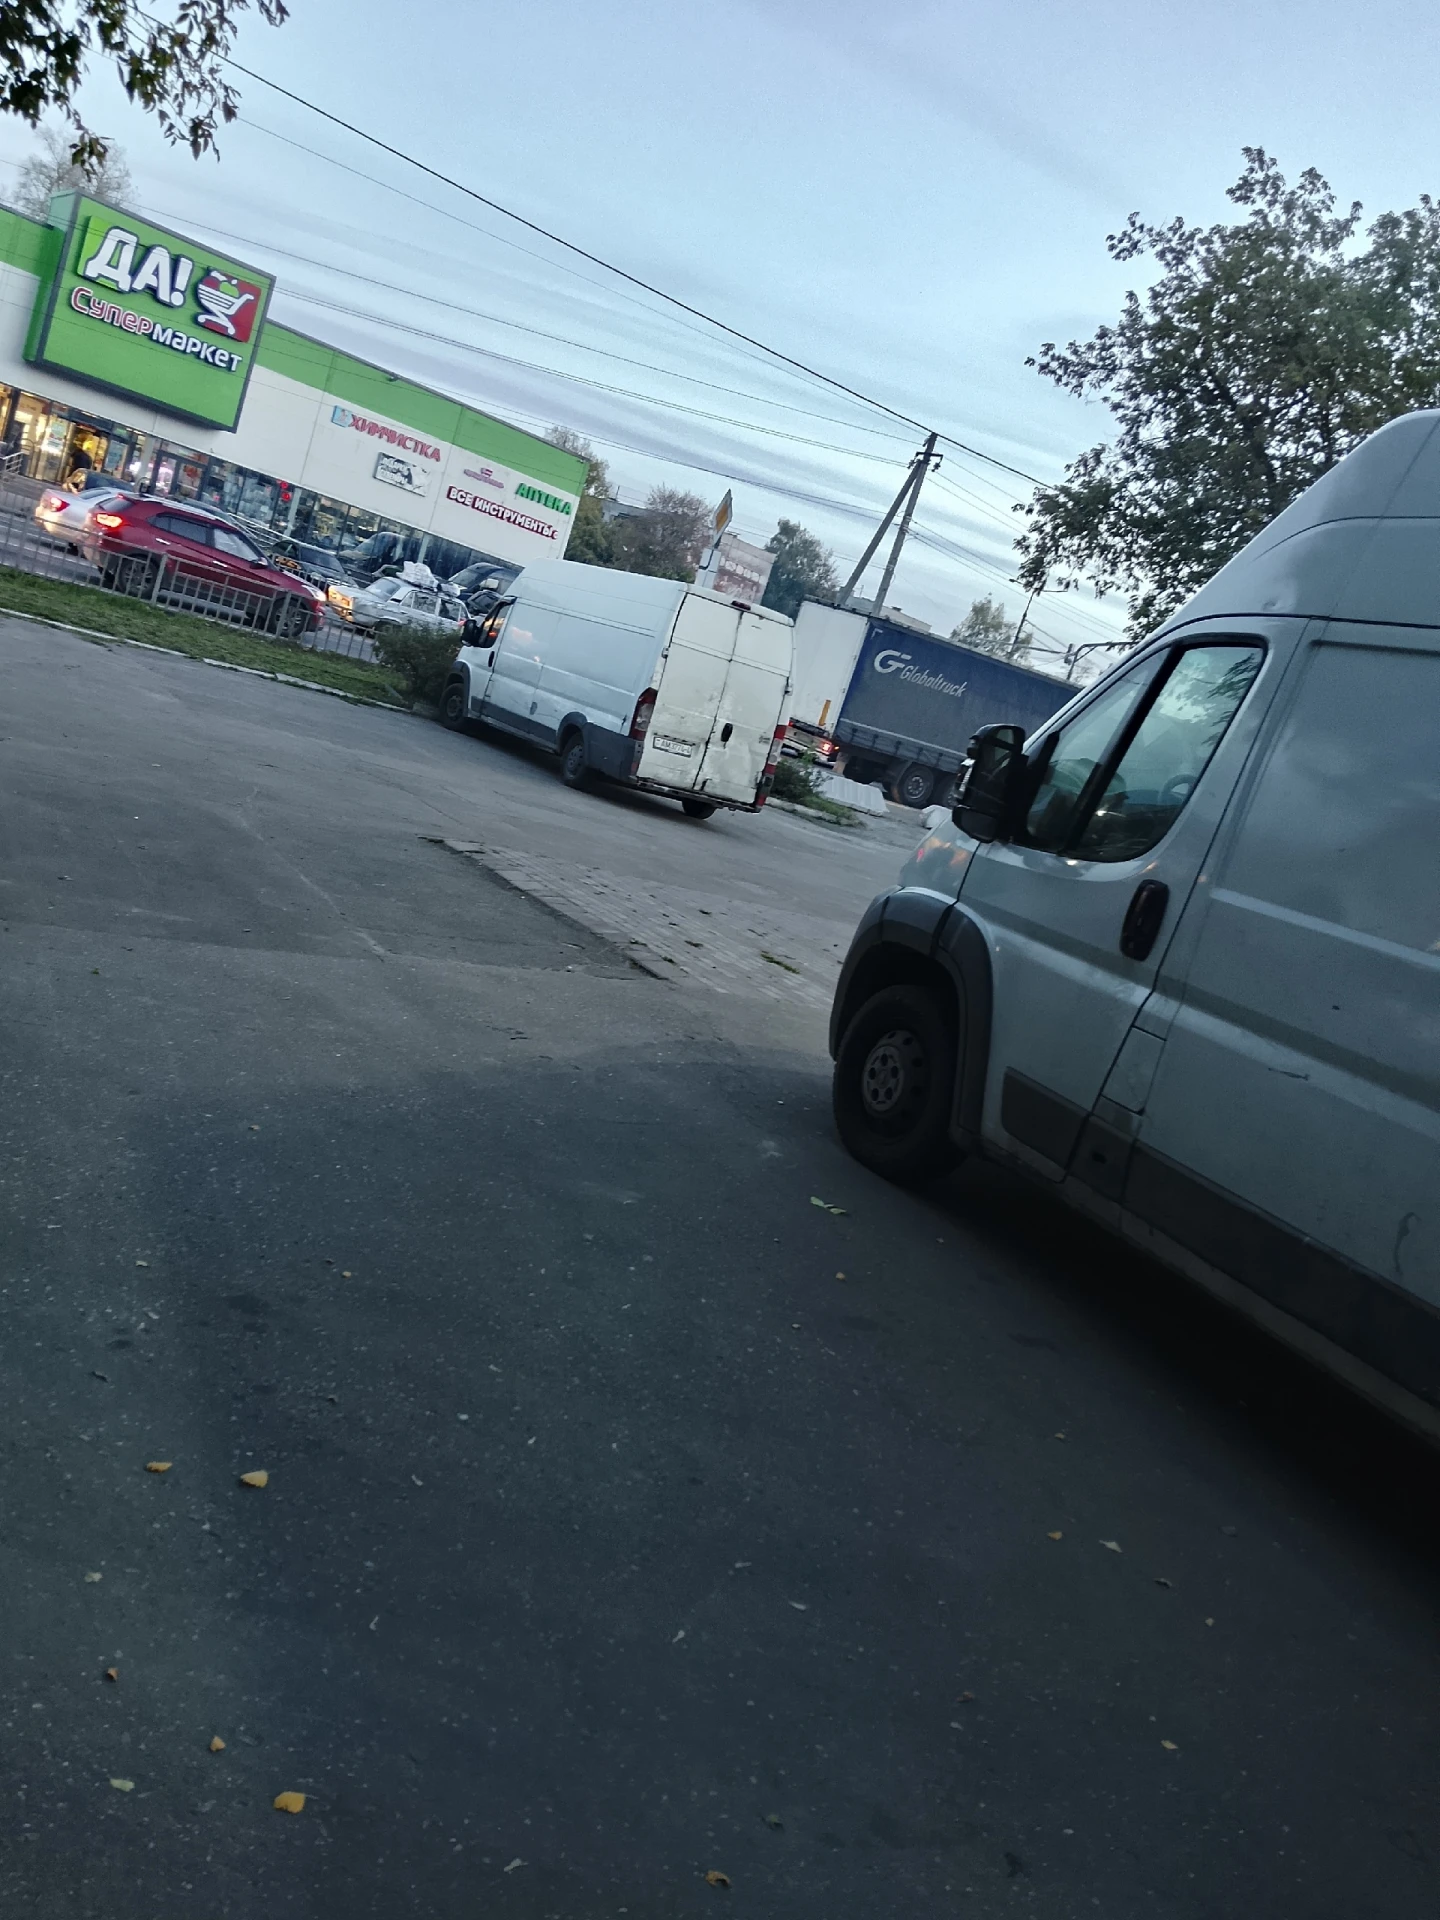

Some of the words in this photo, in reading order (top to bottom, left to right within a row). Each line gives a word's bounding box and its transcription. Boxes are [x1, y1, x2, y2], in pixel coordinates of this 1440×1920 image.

[83, 226, 194, 308] ДА!
[350, 413, 441, 462] ХИМЧИСТКА
[448, 486, 473, 506] ВСЕ
[473, 496, 553, 538] ИНСТРУМЕНТЫ
[516, 482, 572, 515] АПТЕКА
[900, 665, 968, 698] Globaltruck
